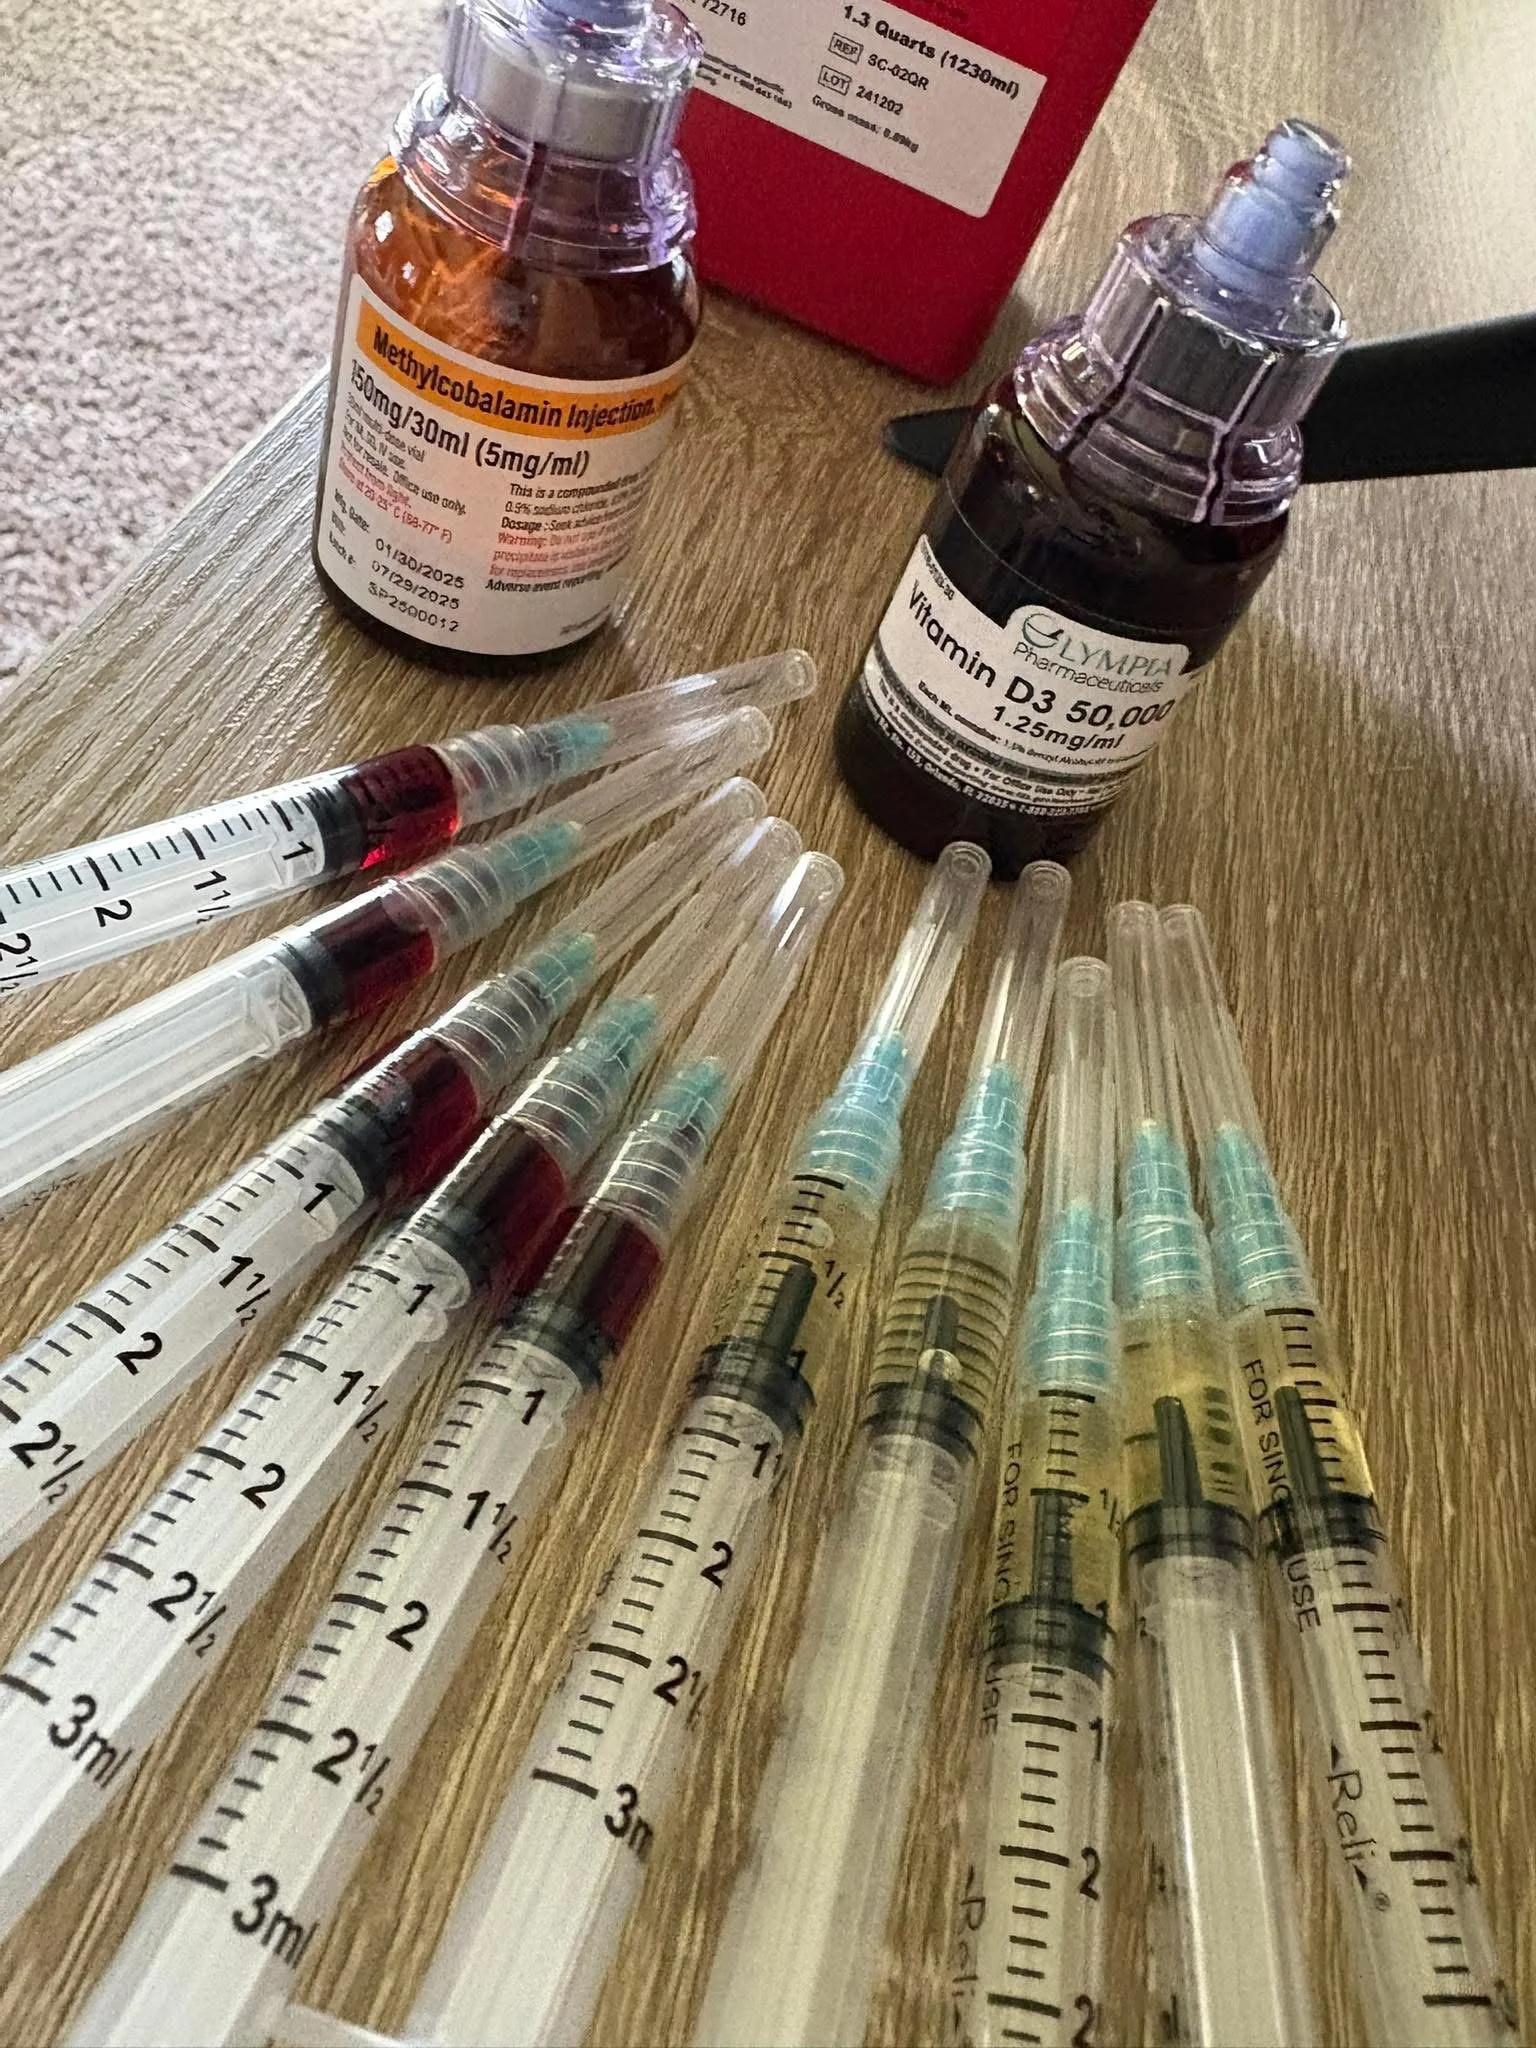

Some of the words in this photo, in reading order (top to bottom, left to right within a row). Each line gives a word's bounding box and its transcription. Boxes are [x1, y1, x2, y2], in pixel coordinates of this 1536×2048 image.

[833, 38, 859, 57] REF
[844, 5, 871, 28] 1.3
[875, 20, 936, 59] Quarts
[939, 50, 1020, 100] (1230ml)
[823, 70, 848, 90] LOT
[855, 86, 904, 116] 241202
[373, 325, 562, 428] Methylcobalamin
[350, 359, 470, 458] 150mg/30ml
[475, 437, 590, 480] (5mg/ml)
[371, 560, 460, 610] 07/29/2025
[375, 537, 465, 589] 01/30/2025
[909, 580, 997, 688] Vitamin
[1004, 676, 1057, 714] D3
[1066, 698, 1176, 732] 50,000
[1013, 641, 1165, 693] Pharmaceuticals
[994, 706, 1126, 752] 1.25mg/ml
[282, 841, 315, 861] 1
[93, 899, 133, 928] 2
[303, 1182, 337, 1214] 1
[406, 1283, 436, 1316] 1
[115, 1331, 164, 1376] 2
[520, 1388, 547, 1426] 1
[240, 1461, 287, 1510] 2
[1241, 1358, 1273, 1427] FOR
[1287, 1557, 1322, 1634] USE
[698, 1539, 734, 1589] 2
[386, 1600, 430, 1651] 2
[47, 1693, 134, 1789] 3ml
[1079, 1845, 1101, 1901] 2
[231, 1872, 321, 1971] 3ml
